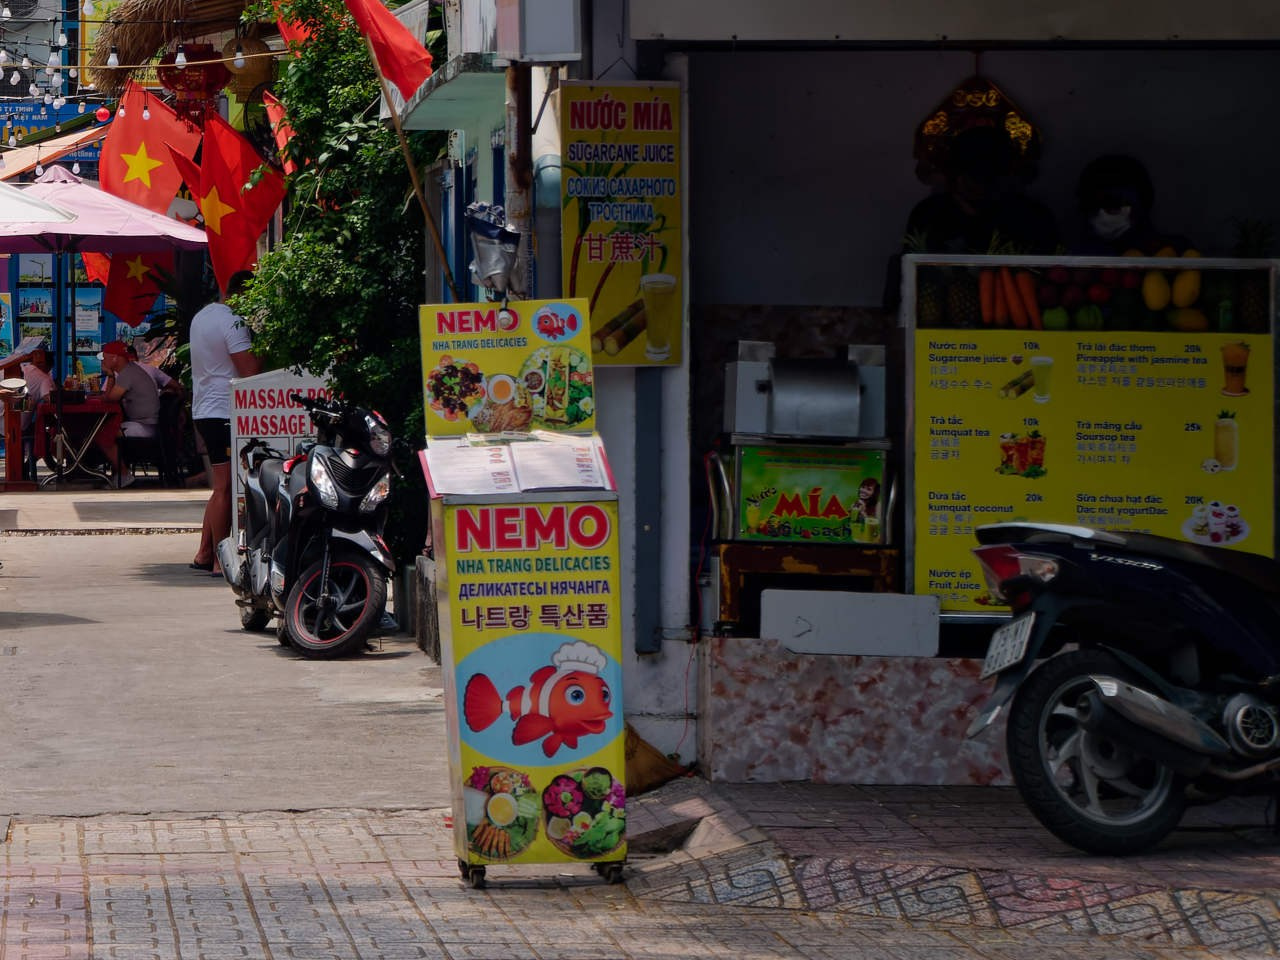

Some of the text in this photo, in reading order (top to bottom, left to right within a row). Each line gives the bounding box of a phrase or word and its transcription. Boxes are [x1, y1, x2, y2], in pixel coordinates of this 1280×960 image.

[570, 93, 673, 131] NƯỚC MÍA
[568, 144, 675, 163] SUGARCANE JUICE
[567, 177, 676, 197] СОК ИЗ САХАРНОГО
[589, 202, 655, 222] ТРОСТНИКА
[584, 232, 663, 262] 甘蔗汁
[436, 308, 519, 335] NEMO
[432, 337, 528, 352] NHA TRANG DELICACIES
[928, 353, 1008, 365] Sugarcane juice
[1076, 353, 1208, 365] Pineapple with jasmine tea
[234, 389, 304, 409] MASSAGE
[237, 415, 306, 436] MASSAGE
[930, 428, 991, 439] kumquat tea
[772, 487, 851, 520] MÍA
[1025, 493, 1043, 502] 20k
[1099, 495, 1124, 503] chua
[928, 503, 1014, 514] kumquat coconut
[1098, 506, 1114, 514] nut
[455, 504, 610, 552] NEMO
[456, 556, 611, 574] NHA TRANG DELICACIES
[928, 569, 972, 580] Nước ép
[459, 581, 610, 601] ДЕЛИКАТЕСЫ НЯЧАНГА
[928, 581, 981, 590] Fruit Juice
[461, 602, 609, 631] 나트랑 특산품
